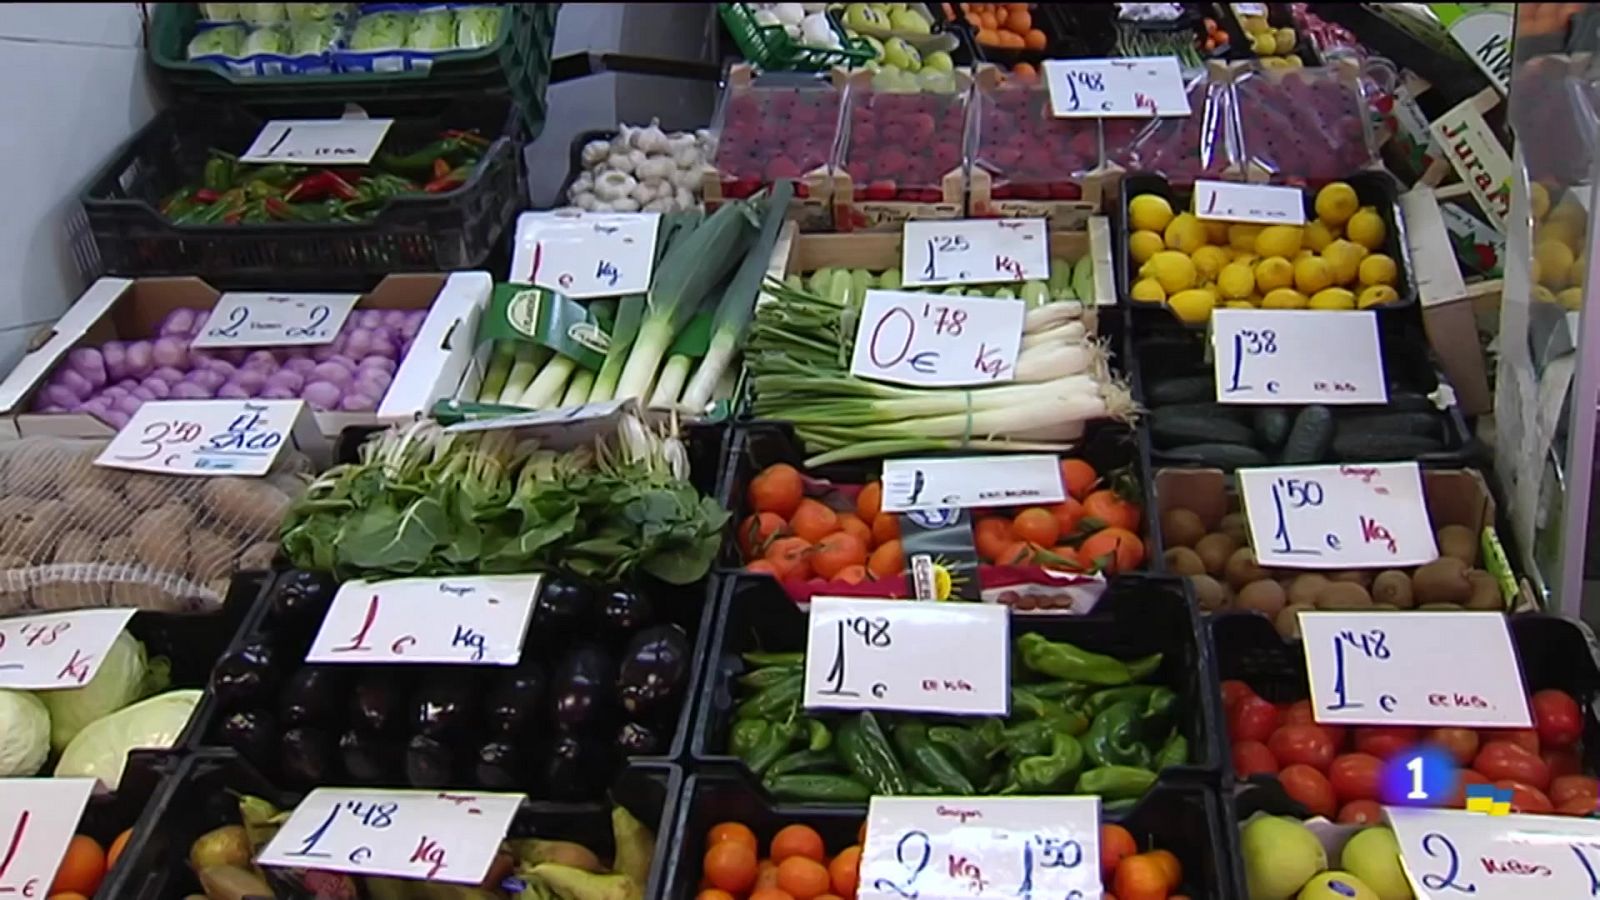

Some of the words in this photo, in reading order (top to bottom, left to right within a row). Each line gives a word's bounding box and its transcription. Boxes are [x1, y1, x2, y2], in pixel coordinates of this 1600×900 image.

[869, 303, 968, 369] 0'78
[973, 342, 1012, 379] Kg
[906, 351, 941, 374] €
[1271, 477, 1324, 556] 1'50
[451, 624, 488, 661] Kg
[817, 616, 892, 697] 1'98
[409, 835, 449, 878] Kg
[1422, 832, 1477, 894] 2
